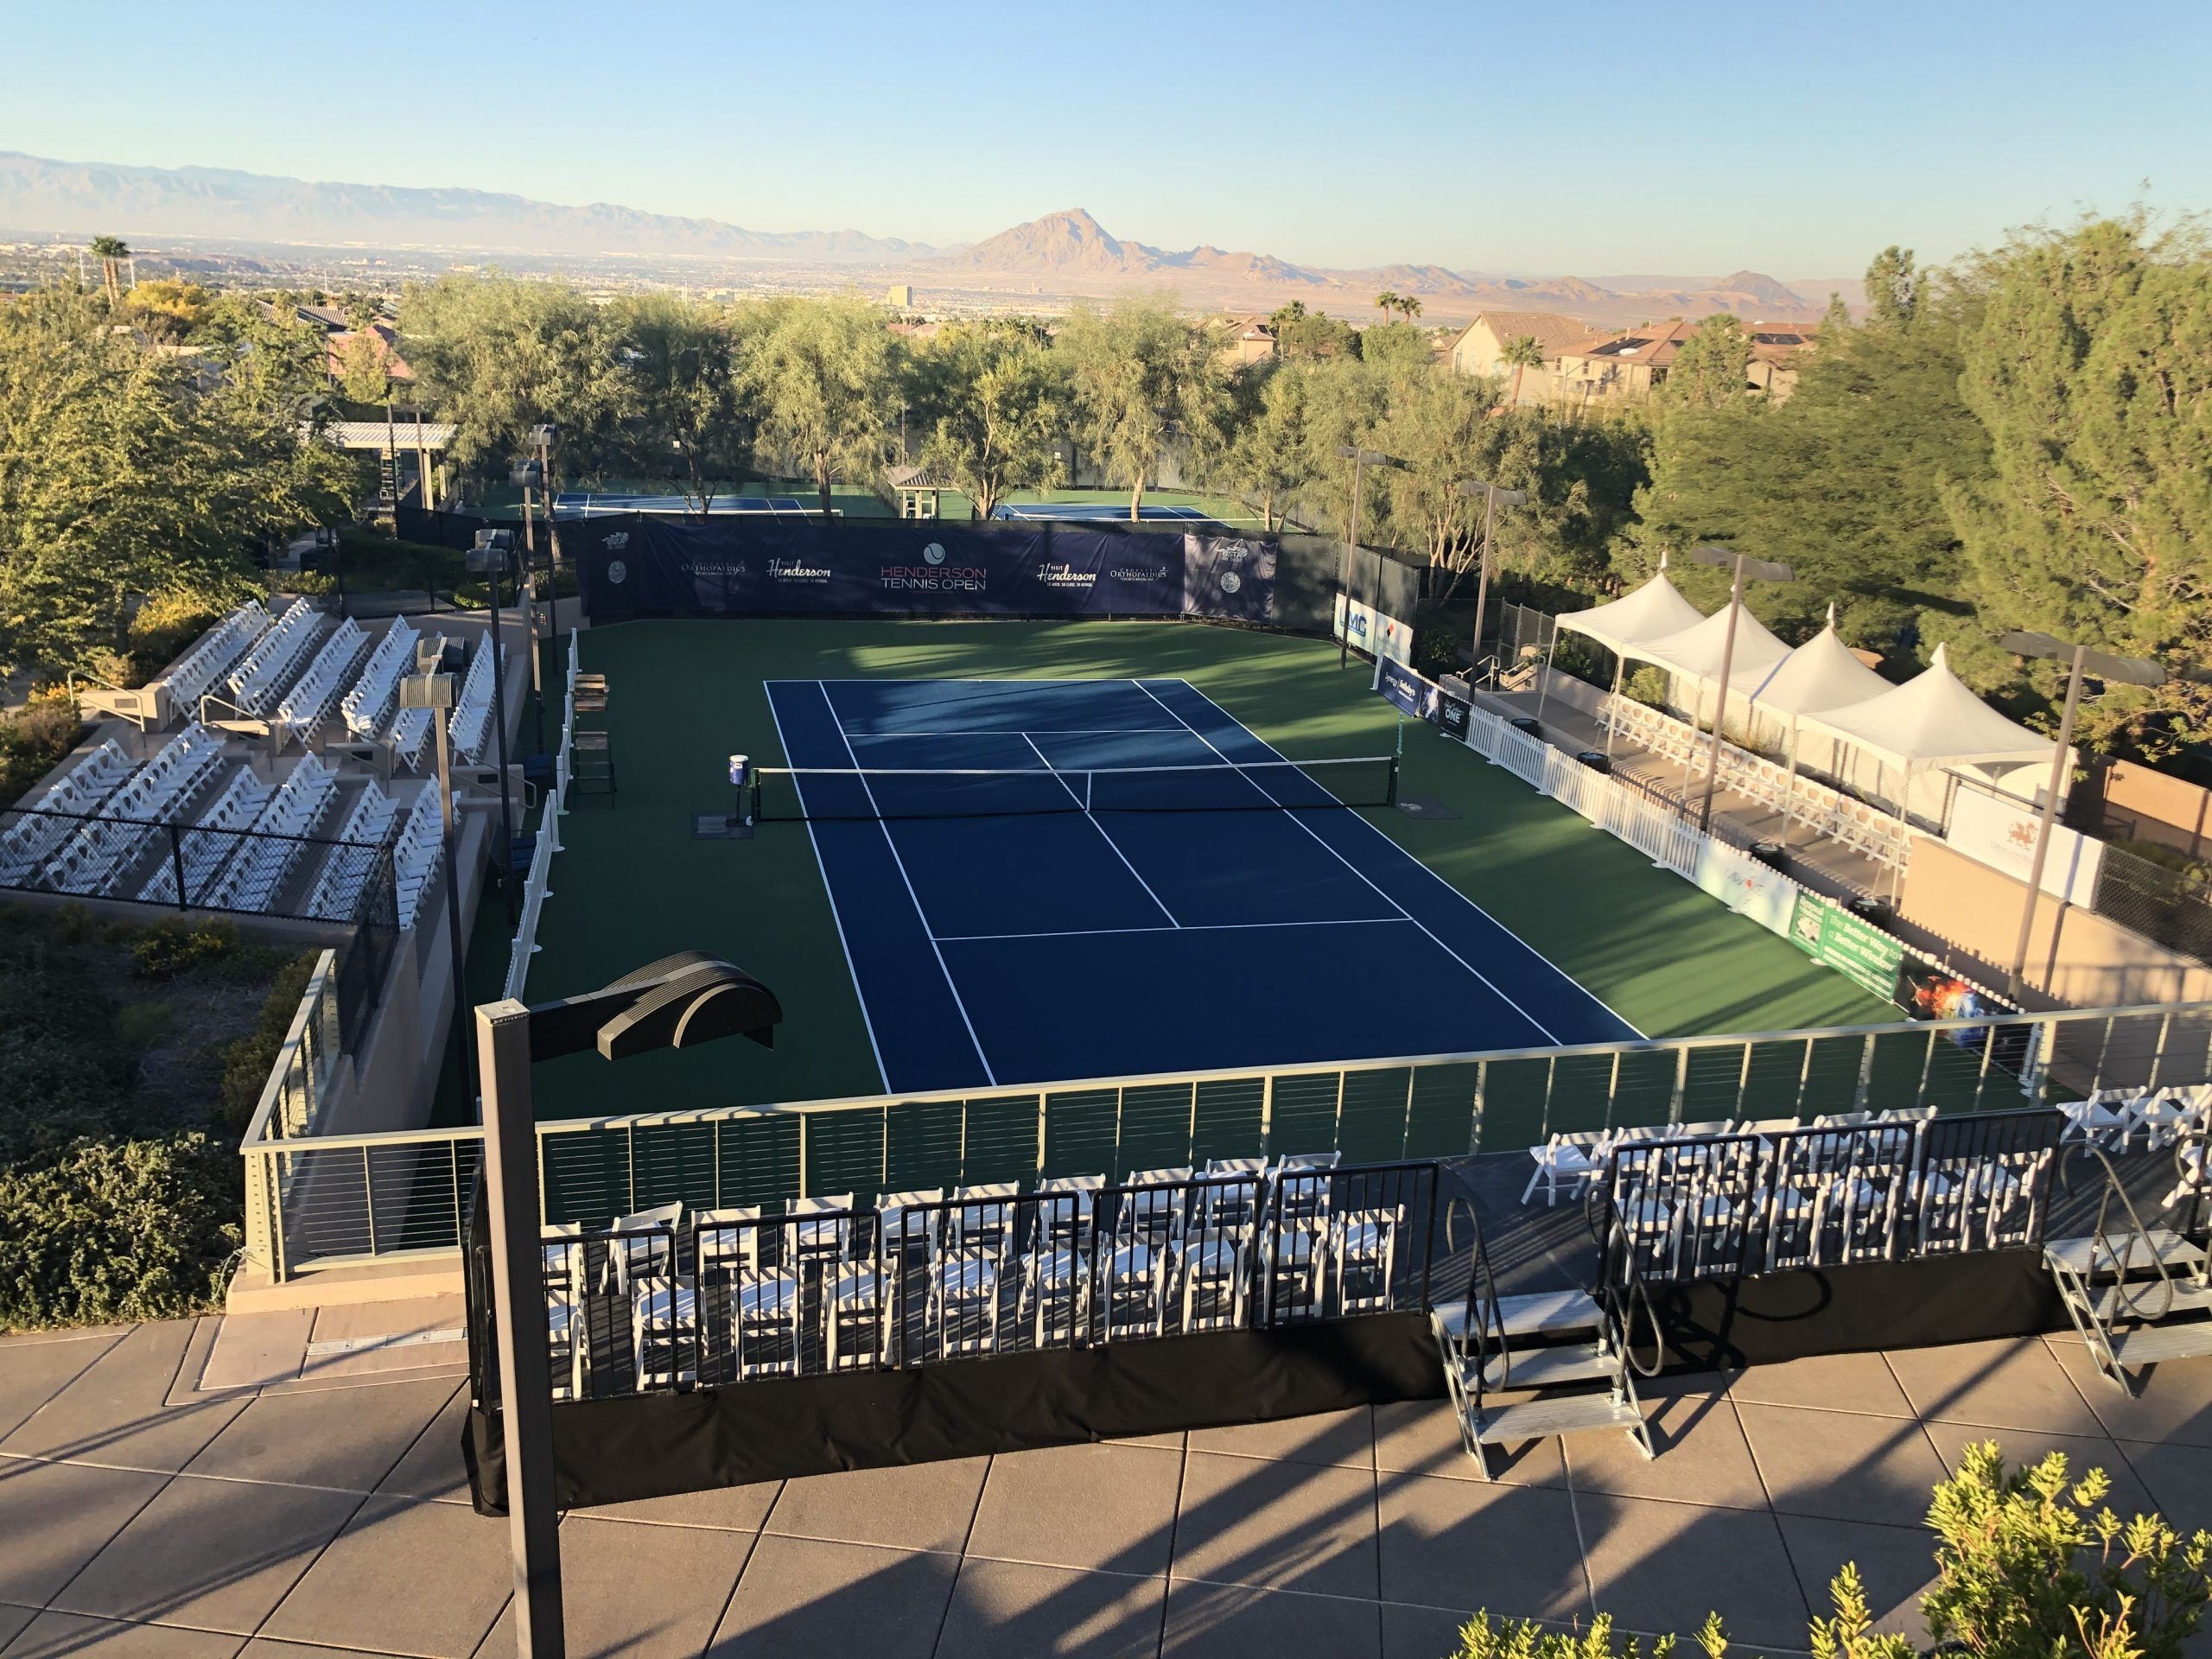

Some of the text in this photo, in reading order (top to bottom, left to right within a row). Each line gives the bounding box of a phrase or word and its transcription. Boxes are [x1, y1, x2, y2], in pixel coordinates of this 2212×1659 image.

[766, 557, 831, 578] Henderson
[880, 566, 987, 579] HENDERSON
[1037, 563, 1096, 582] Henderson
[880, 578, 986, 590] TENNIS OPEN
[1445, 709, 1461, 724] ONE
[1829, 914, 1845, 930] The
[1843, 922, 1870, 943] Better
[1868, 936, 1889, 959] Way
[1888, 949, 1899, 960] to
[1827, 930, 1897, 972] a Better Window
